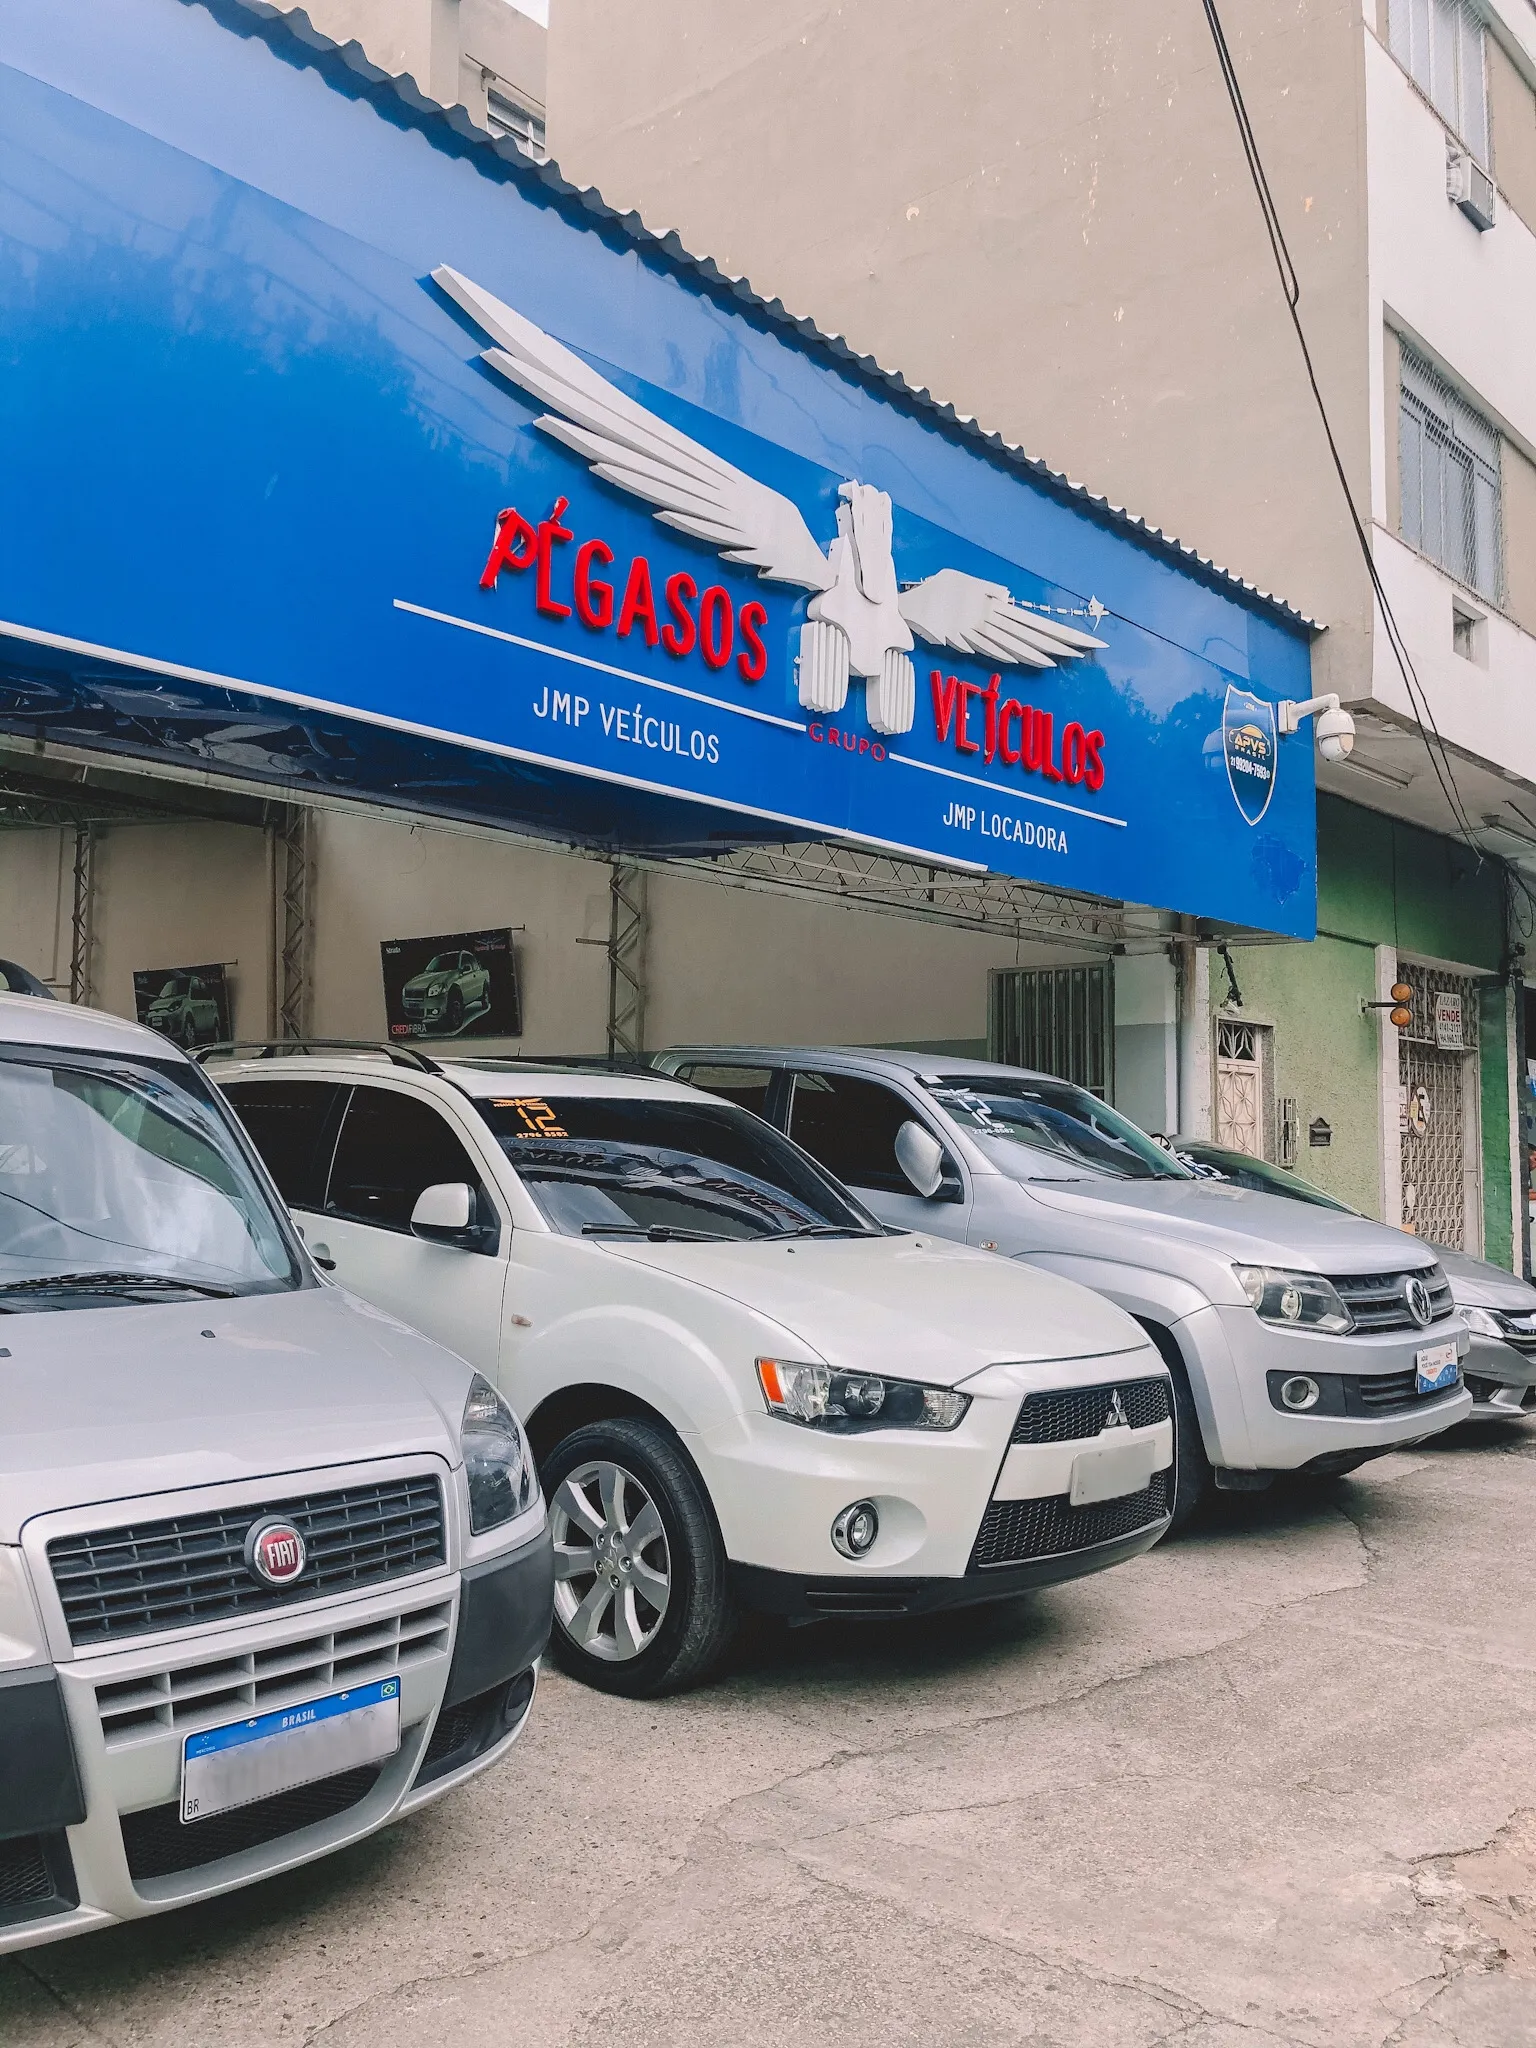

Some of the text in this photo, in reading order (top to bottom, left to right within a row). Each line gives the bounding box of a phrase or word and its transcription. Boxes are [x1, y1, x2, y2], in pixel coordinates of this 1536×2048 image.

[479, 496, 768, 681] PÉGASOS
[533, 686, 720, 764] JMP VEÍCULOS
[808, 722, 886, 762] GRUPO
[930, 670, 1105, 791] VEÍCULOS
[1234, 733, 1266, 755] APVS
[943, 801, 1068, 854] JMP LOCADORA
[1437, 1009, 1460, 1022] VENDE
[266, 1539, 296, 1569] FIAT
[281, 1709, 317, 1728] BRASIL
[187, 1798, 200, 1816] BR
